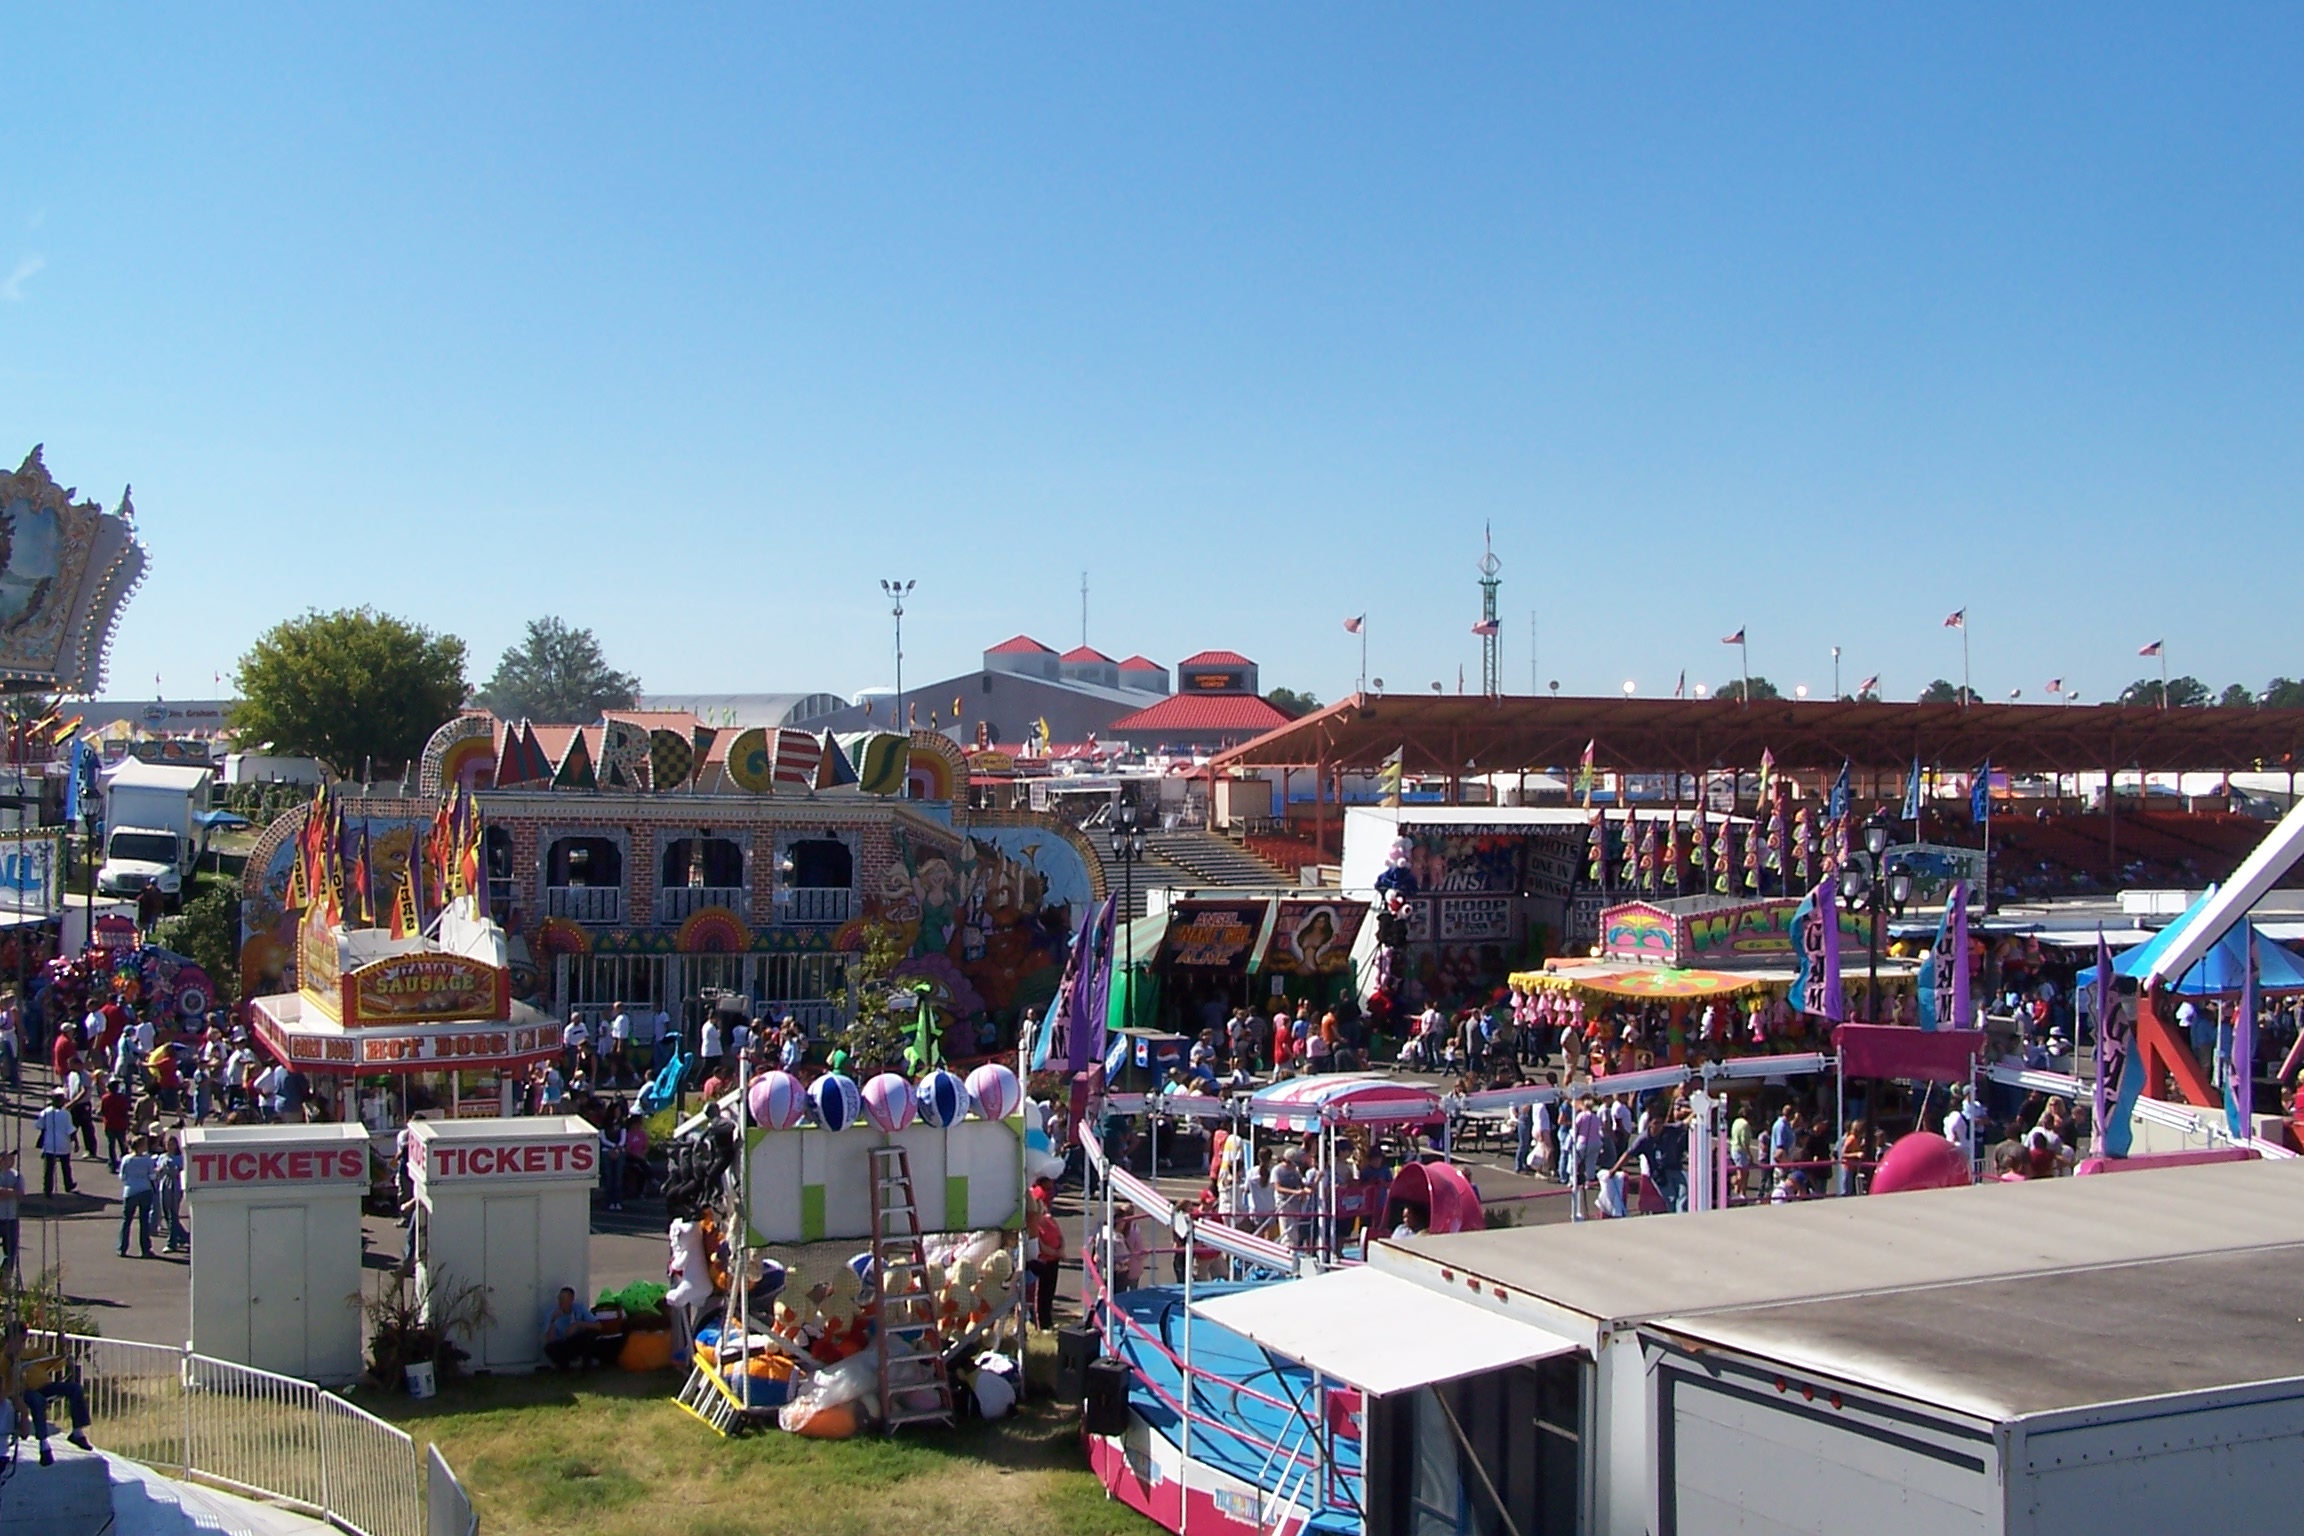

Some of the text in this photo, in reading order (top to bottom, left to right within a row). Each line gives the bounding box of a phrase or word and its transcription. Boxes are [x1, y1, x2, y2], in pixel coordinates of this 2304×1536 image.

[493, 715, 911, 797] MARDI GRAS
[1445, 900, 1508, 911] HOOP
[1445, 912, 1507, 923] SHOTS
[1690, 905, 1873, 952] WATR
[399, 963, 455, 976] ITALIAN
[376, 974, 475, 994] SAUSAGE
[366, 1036, 425, 1060] HOT
[435, 1033, 508, 1057] DOGS
[191, 1148, 364, 1182] TICKETS
[432, 1143, 595, 1176] TICKETS
